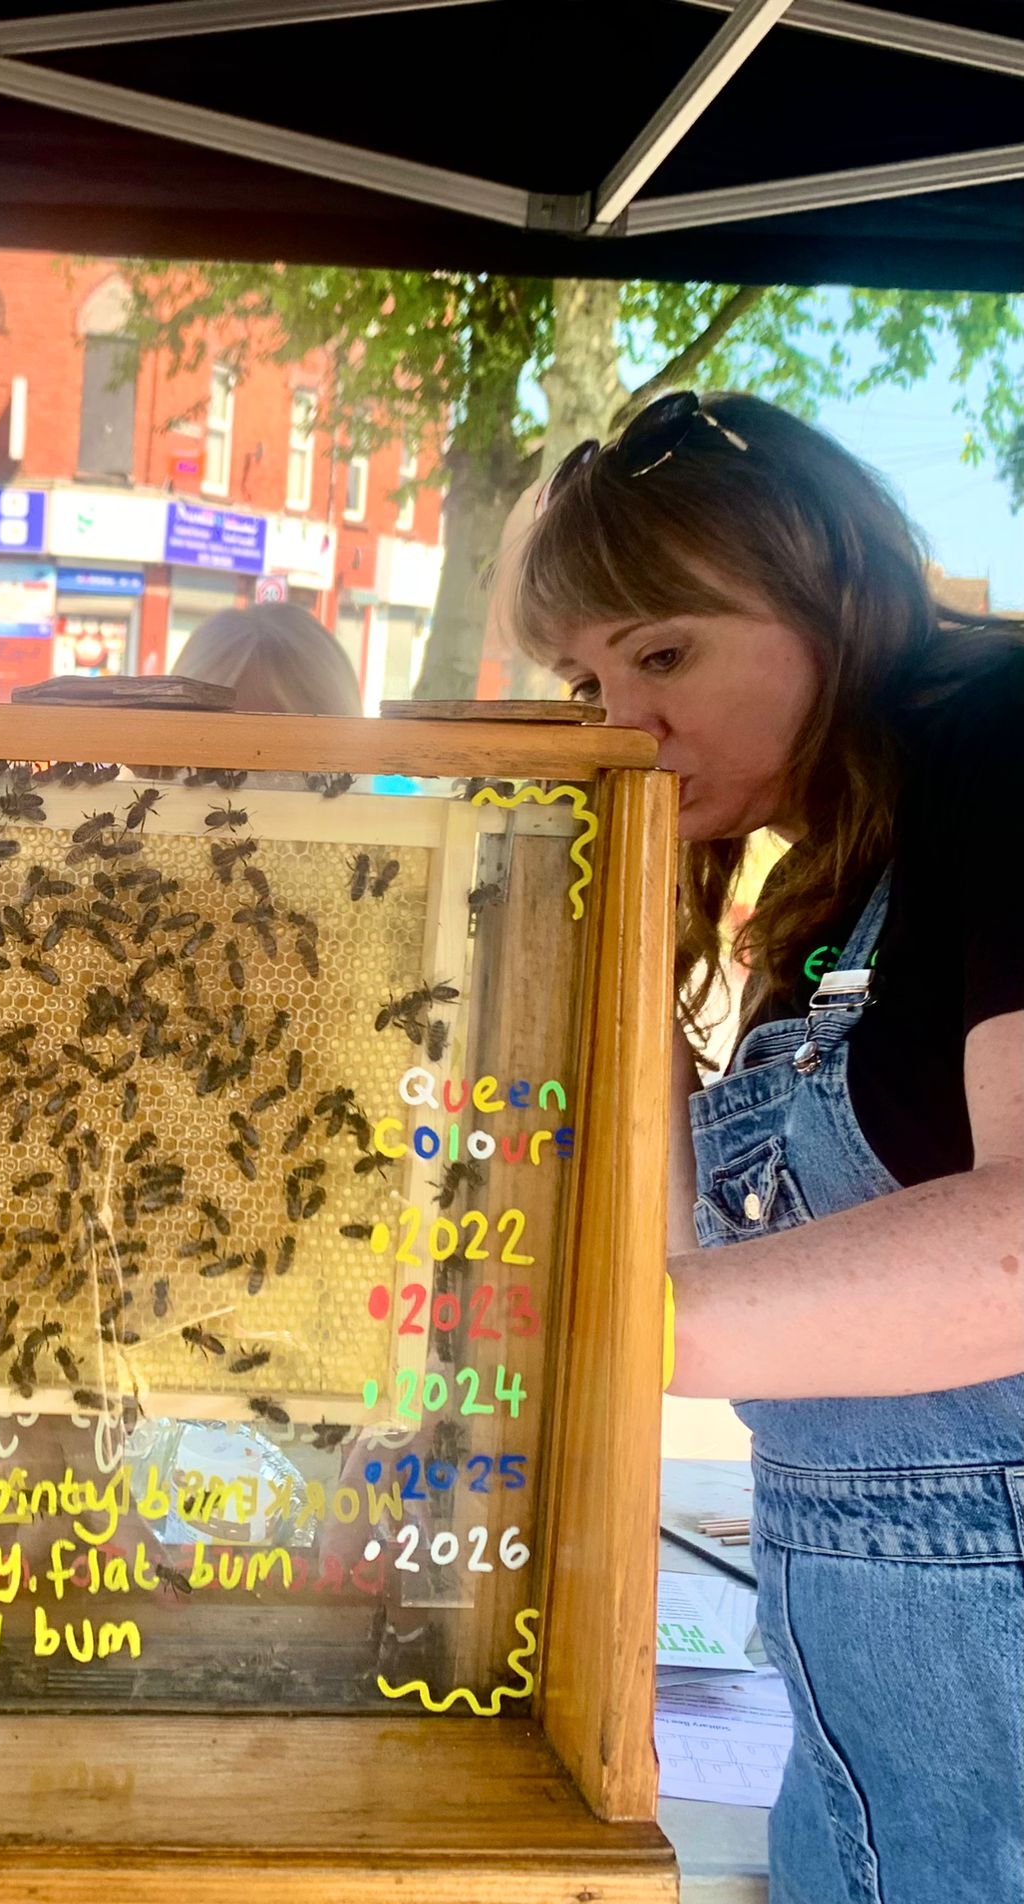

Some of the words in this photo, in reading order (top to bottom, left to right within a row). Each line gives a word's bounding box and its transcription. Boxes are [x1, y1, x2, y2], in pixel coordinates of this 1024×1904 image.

[399, 1066, 566, 1113] Queen
[374, 1117, 574, 1166] Colours
[395, 1207, 535, 1267] 2022
[397, 1283, 541, 1340] 2023
[395, 1364, 528, 1420] 2024
[137, 1464, 248, 1524] bum
[396, 1454, 527, 1499] 2025
[47, 1539, 159, 1599] flat
[189, 1542, 292, 1590] bum
[395, 1526, 531, 1573] 2026
[34, 1606, 141, 1664] bum
